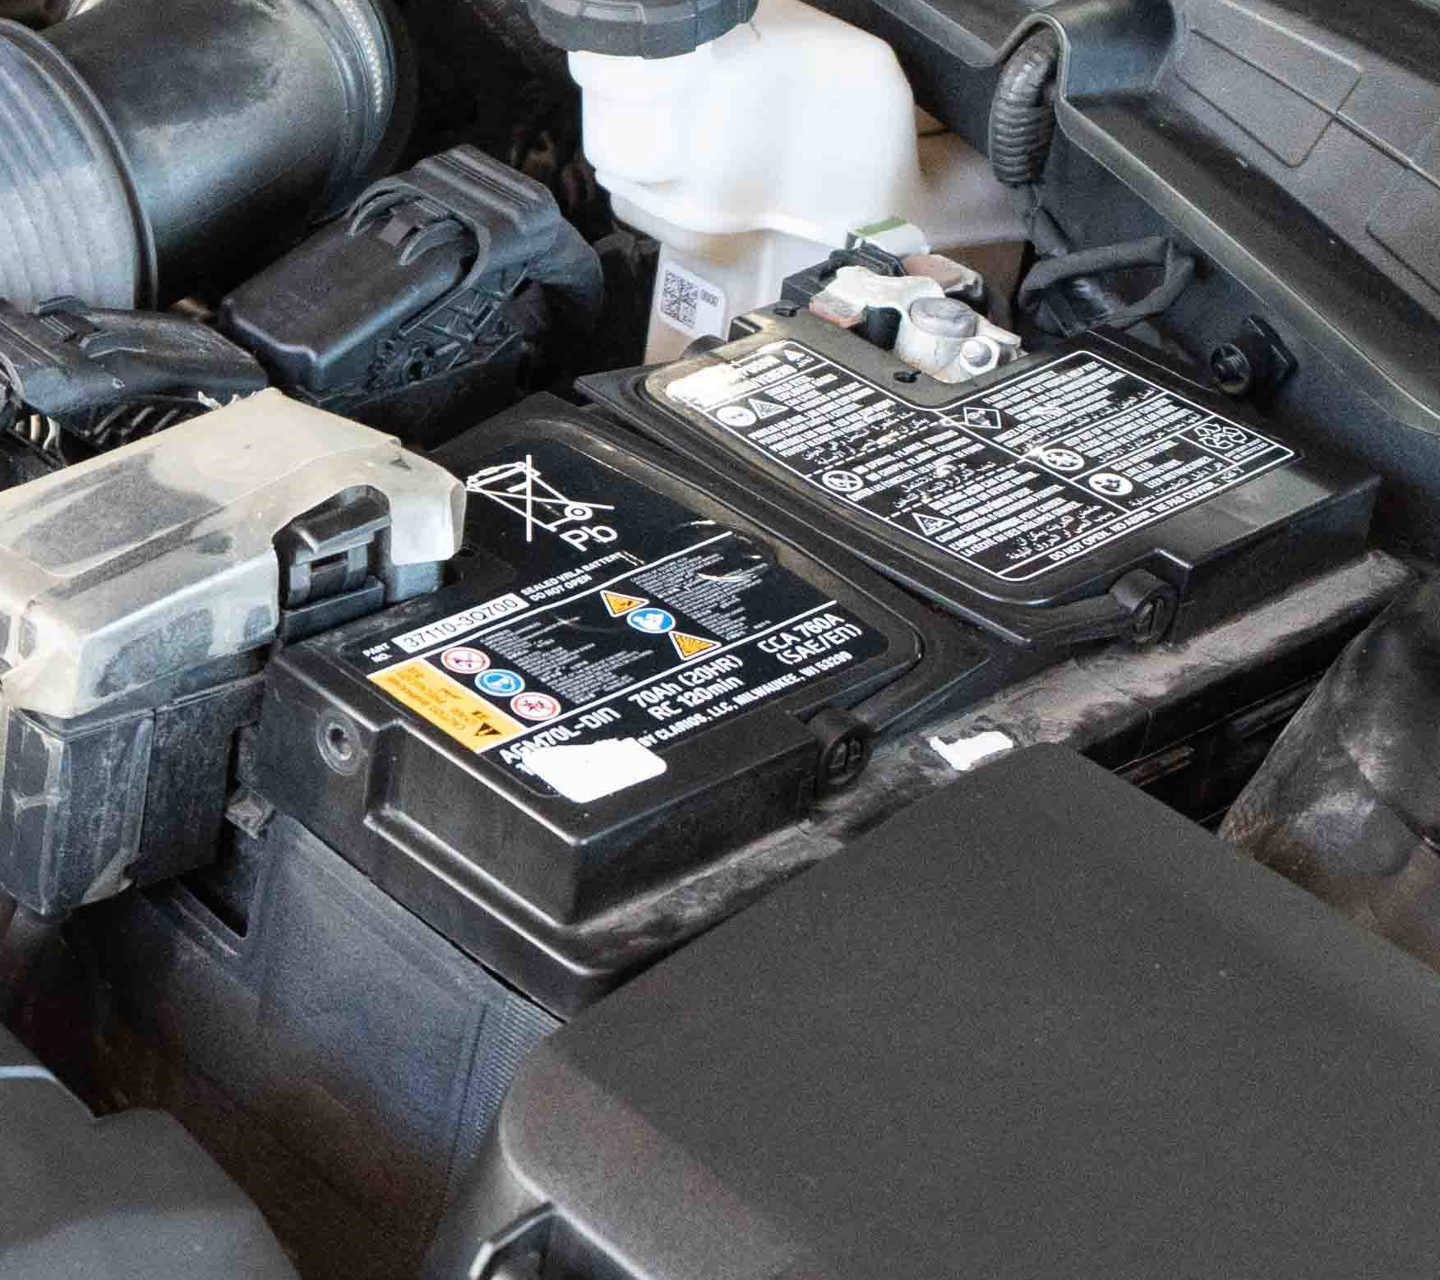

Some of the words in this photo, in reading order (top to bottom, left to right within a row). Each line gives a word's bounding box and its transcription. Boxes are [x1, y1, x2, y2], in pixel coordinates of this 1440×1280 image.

[559, 523, 618, 552] Pb
[404, 599, 517, 646] 37110-3Q700
[757, 629, 800, 652] CCA
[796, 613, 843, 636] 760A
[362, 642, 389, 656] PART
[628, 683, 681, 707] 70Ah
[678, 655, 742, 685] (20HR)
[647, 701, 679, 719] RC
[677, 677, 742, 706] 120min
[706, 701, 737, 716] LLC,
[733, 673, 804, 704] MILWAUKEE,
[799, 665, 819, 676] WI
